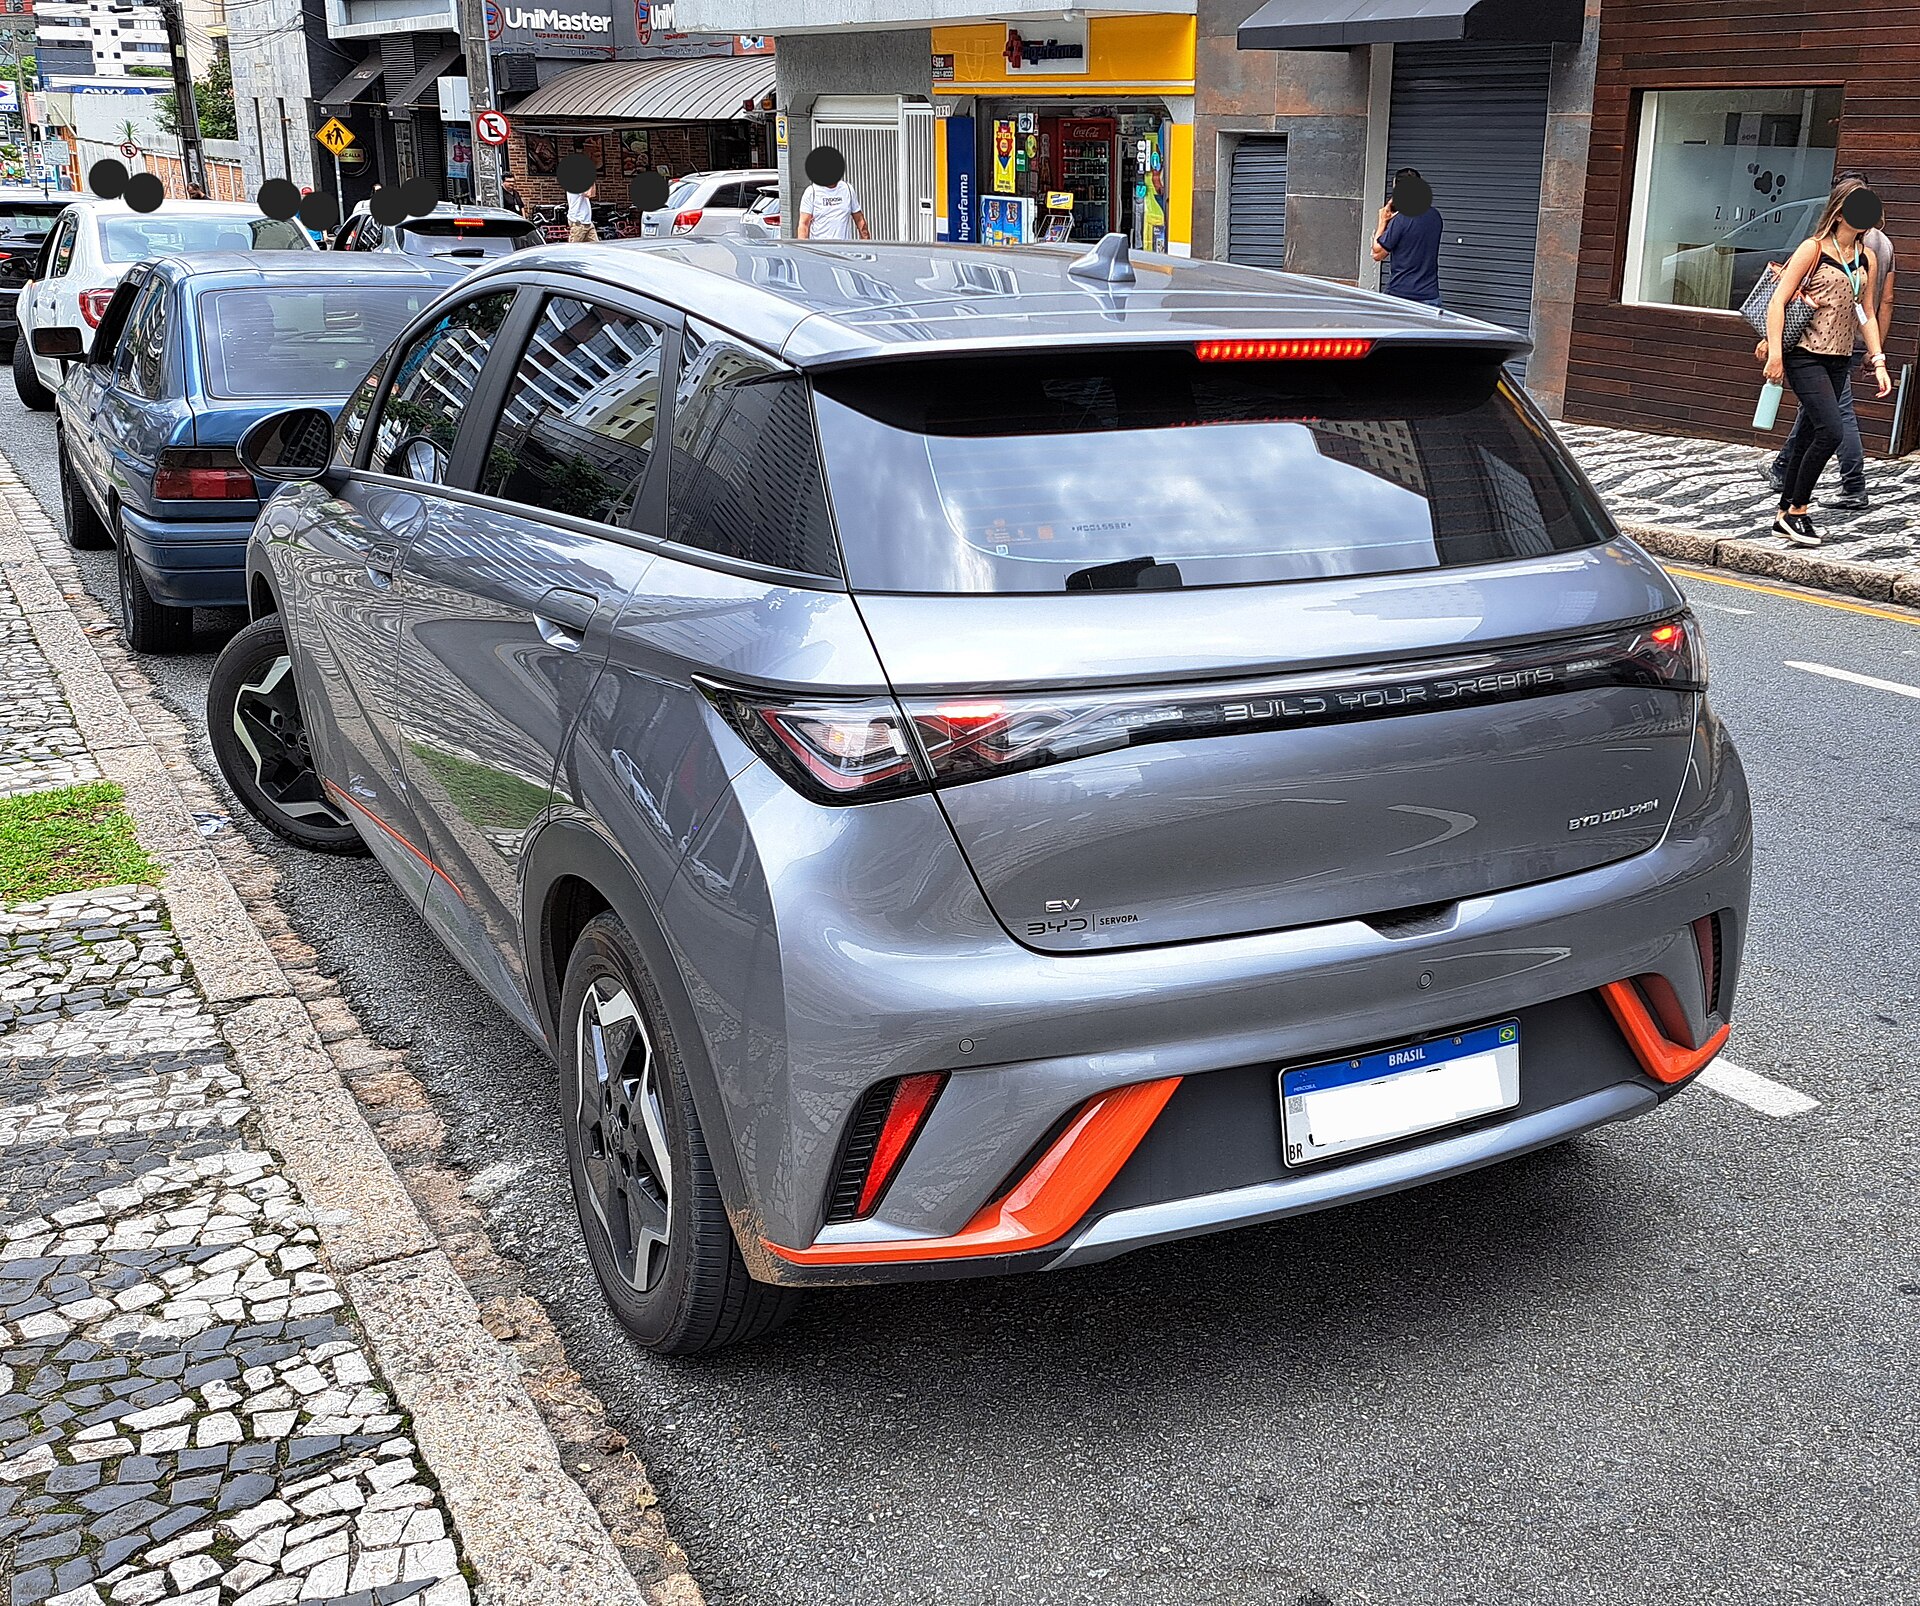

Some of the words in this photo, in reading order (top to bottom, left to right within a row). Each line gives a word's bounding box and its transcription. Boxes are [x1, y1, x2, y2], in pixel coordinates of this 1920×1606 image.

[505, 7, 611, 32] UniMaster
[650, 3, 676, 30] UniM
[0, 103, 16, 111] NYX
[957, 174, 971, 241] hiperfarma
[1222, 696, 1328, 722] BUILD
[1337, 686, 1428, 710] YOUR
[1435, 666, 1555, 699] DREAMS
[1568, 814, 1600, 831] BYD
[1602, 799, 1659, 823] DOLPHIN
[1045, 898, 1080, 912] EV
[1027, 917, 1088, 936] BYD
[1099, 914, 1139, 926] SERVOPA
[1388, 1048, 1426, 1067] BRASIL
[1288, 1142, 1304, 1161] BR
